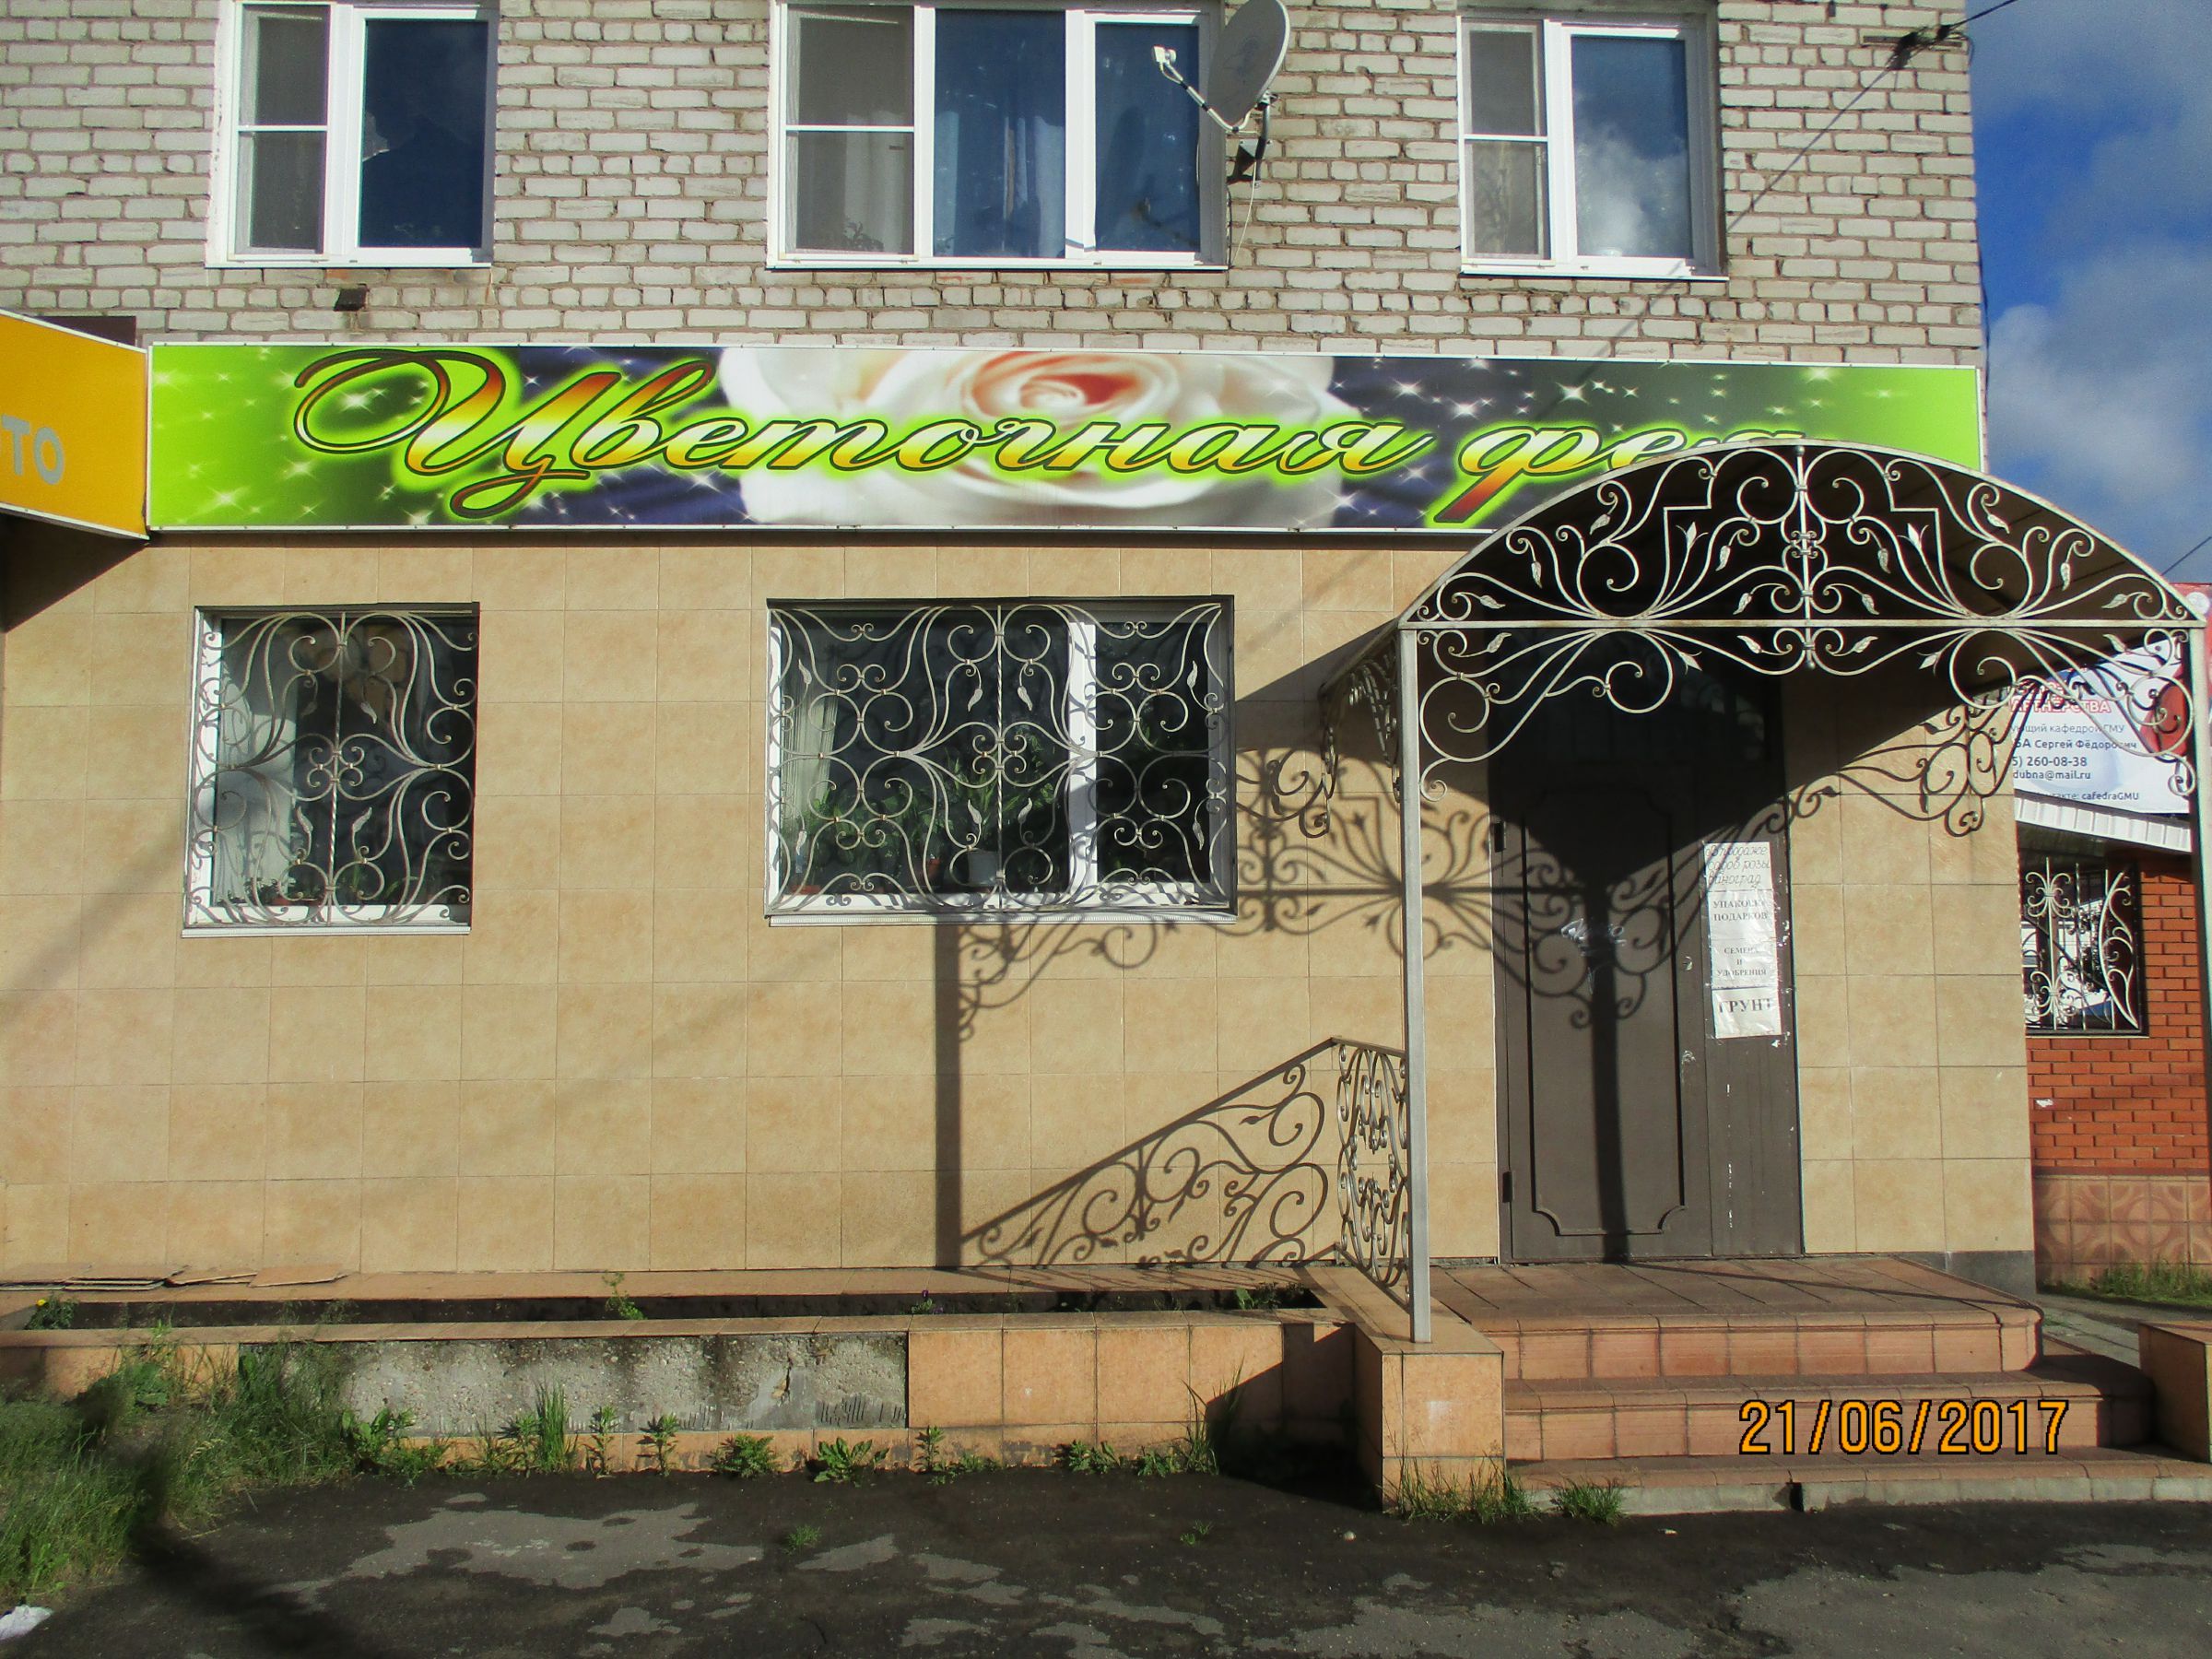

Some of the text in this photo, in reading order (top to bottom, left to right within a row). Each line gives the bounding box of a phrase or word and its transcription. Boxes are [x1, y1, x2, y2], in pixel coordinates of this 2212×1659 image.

[294, 348, 1805, 524] Цветочная фе
[2034, 739, 2073, 750] Сергей
[2027, 756, 2088, 767] 260-08-38
[2081, 791, 2139, 801] cafedraGMU
[1713, 912, 1769, 922] ПОДАРКОВ
[1724, 947, 1759, 955] СЕМЕН
[1718, 997, 1772, 1014] ГРУНТ
